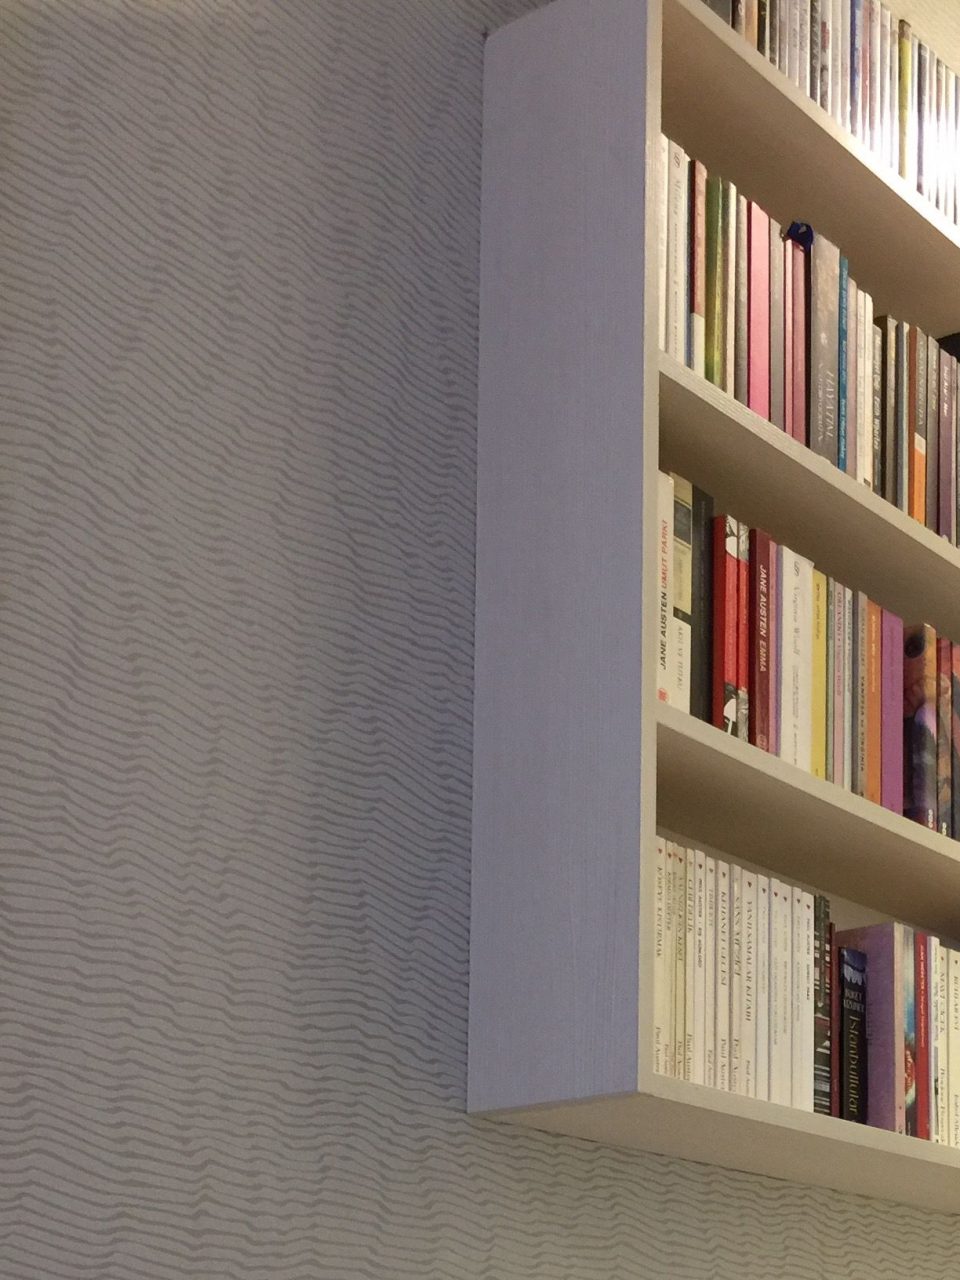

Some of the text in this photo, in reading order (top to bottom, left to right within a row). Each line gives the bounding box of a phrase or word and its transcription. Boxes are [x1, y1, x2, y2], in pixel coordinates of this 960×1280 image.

[659, 592, 668, 638] AUSTEN
[759, 564, 767, 673] JANE AUSTEN EMMA
[659, 639, 668, 671] JANE
